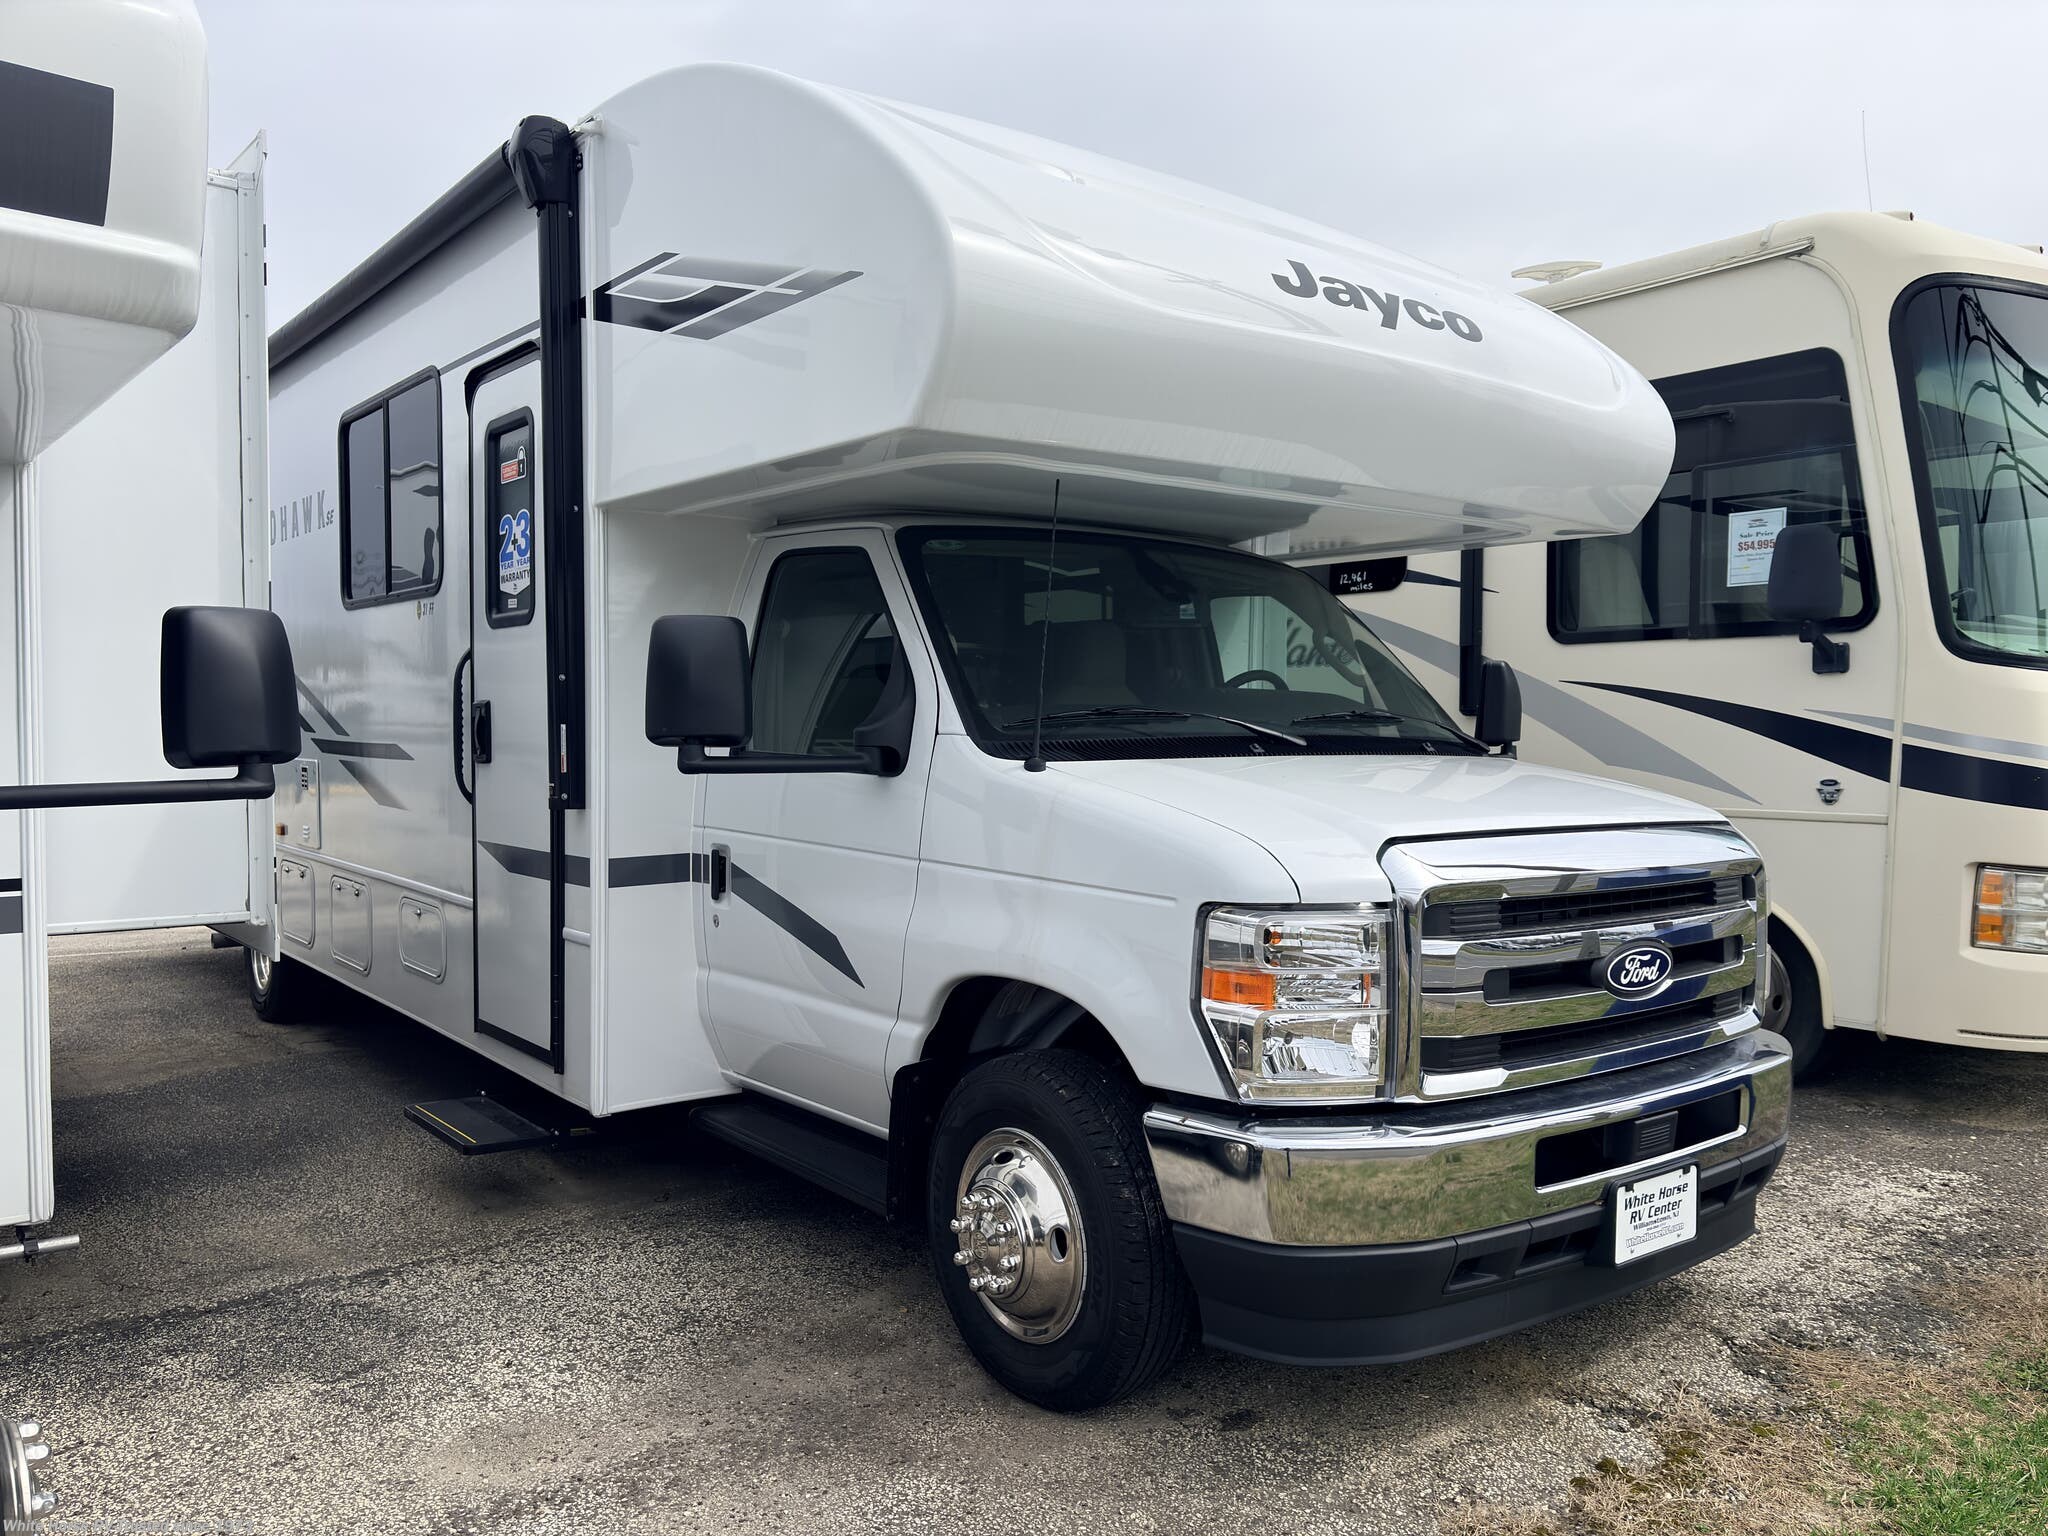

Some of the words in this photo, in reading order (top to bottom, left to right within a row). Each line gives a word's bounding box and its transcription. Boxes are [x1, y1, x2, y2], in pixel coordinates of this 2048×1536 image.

[1271, 259, 1483, 343] Jayco
[1740, 531, 1753, 539] Sale
[1756, 530, 1774, 538] Price
[501, 560, 514, 571] YEAR
[501, 568, 530, 584] WARRANTY
[1350, 582, 1373, 591] miles
[1620, 954, 1660, 985] Ford
[1624, 1192, 1655, 1211] White
[1658, 1182, 1689, 1200] Horse
[1629, 1207, 1646, 1225] RV
[1647, 1199, 1683, 1219] Center
